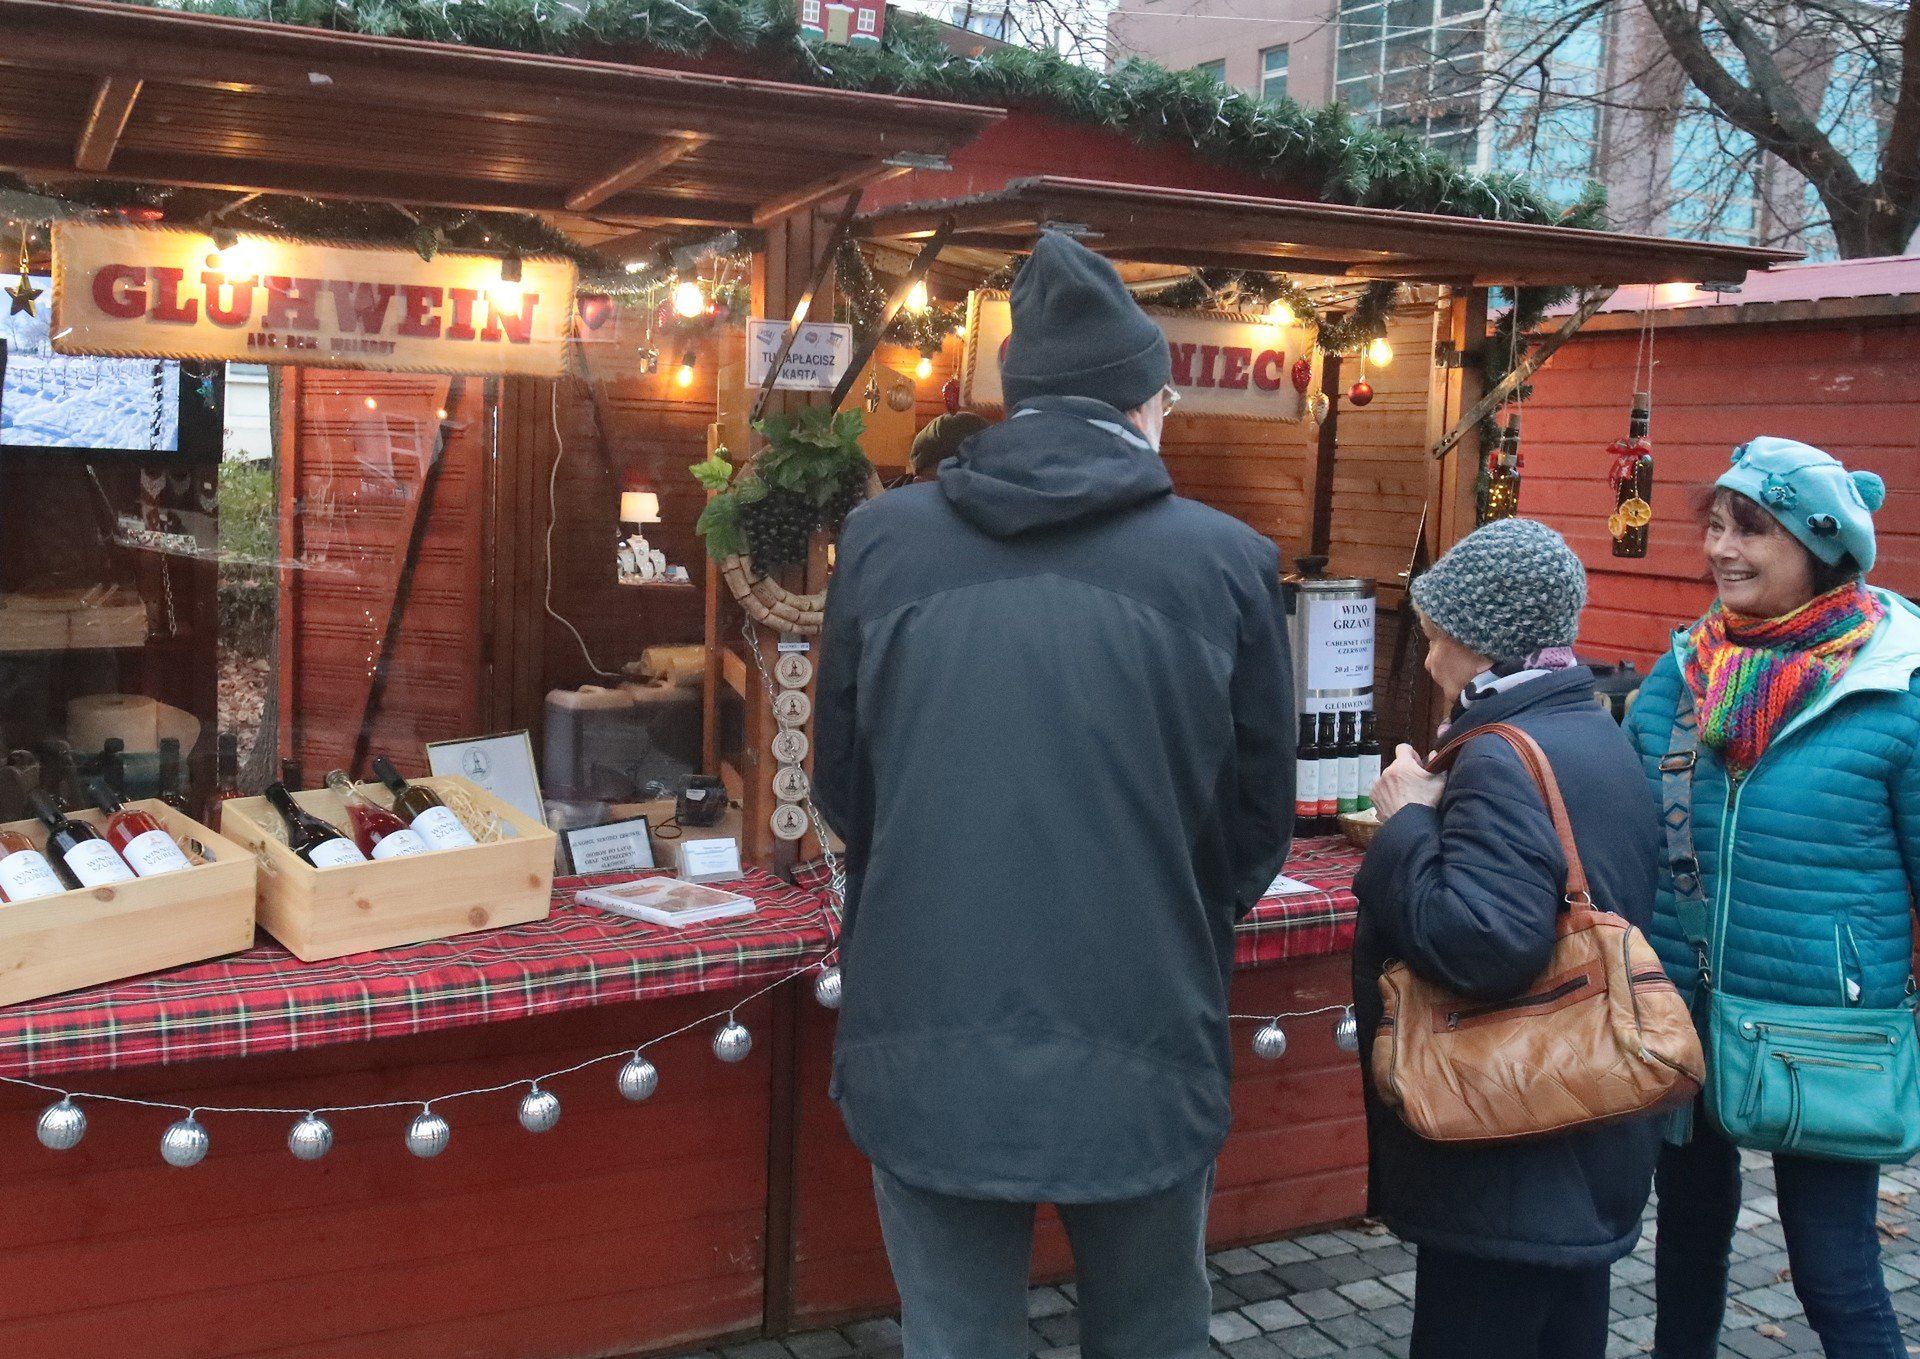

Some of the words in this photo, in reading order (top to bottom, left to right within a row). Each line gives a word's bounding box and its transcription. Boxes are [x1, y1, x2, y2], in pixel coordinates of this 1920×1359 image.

[92, 253, 540, 345] GLÜHWEIN
[785, 353, 836, 366] APŁACISZ
[1341, 604, 1368, 615] WINO
[1333, 617, 1370, 630] GRZANE
